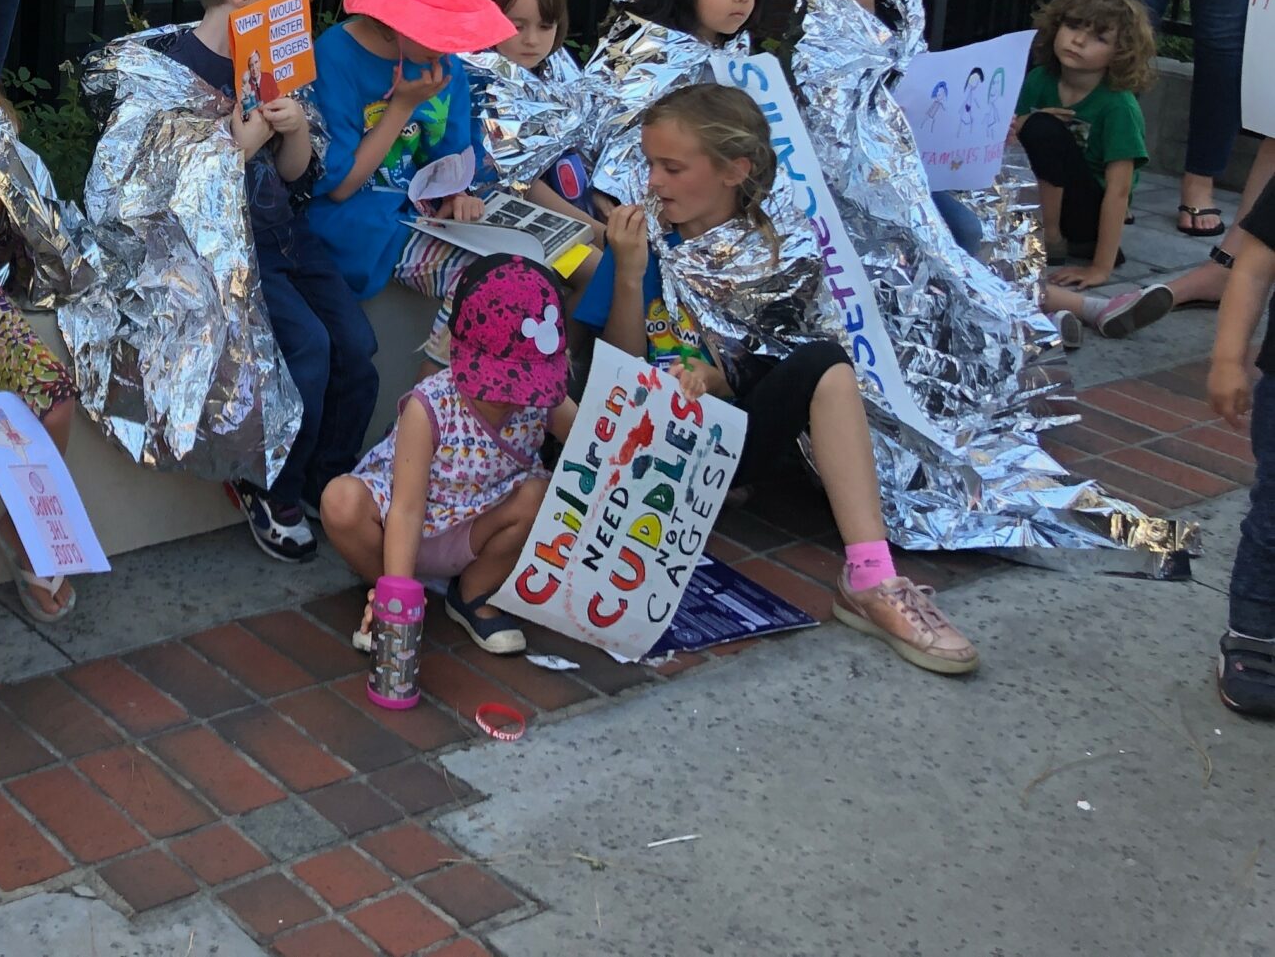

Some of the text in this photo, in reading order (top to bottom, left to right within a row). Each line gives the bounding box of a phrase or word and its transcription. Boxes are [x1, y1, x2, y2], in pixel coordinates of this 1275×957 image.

[236, 13, 263, 33] WHAT
[270, 18, 303, 41] MISTER
[272, 37, 310, 62] ROGERS
[274, 63, 293, 82] DO?
[29, 495, 64, 517] CAMPS
[515, 385, 628, 605] Children
[587, 391, 704, 628] CUDDLES
[47, 520, 69, 541] THE
[582, 487, 630, 572] NEED
[647, 444, 737, 623] CAGES!
[655, 506, 684, 567] NOT
[51, 542, 83, 565] CLOSE
